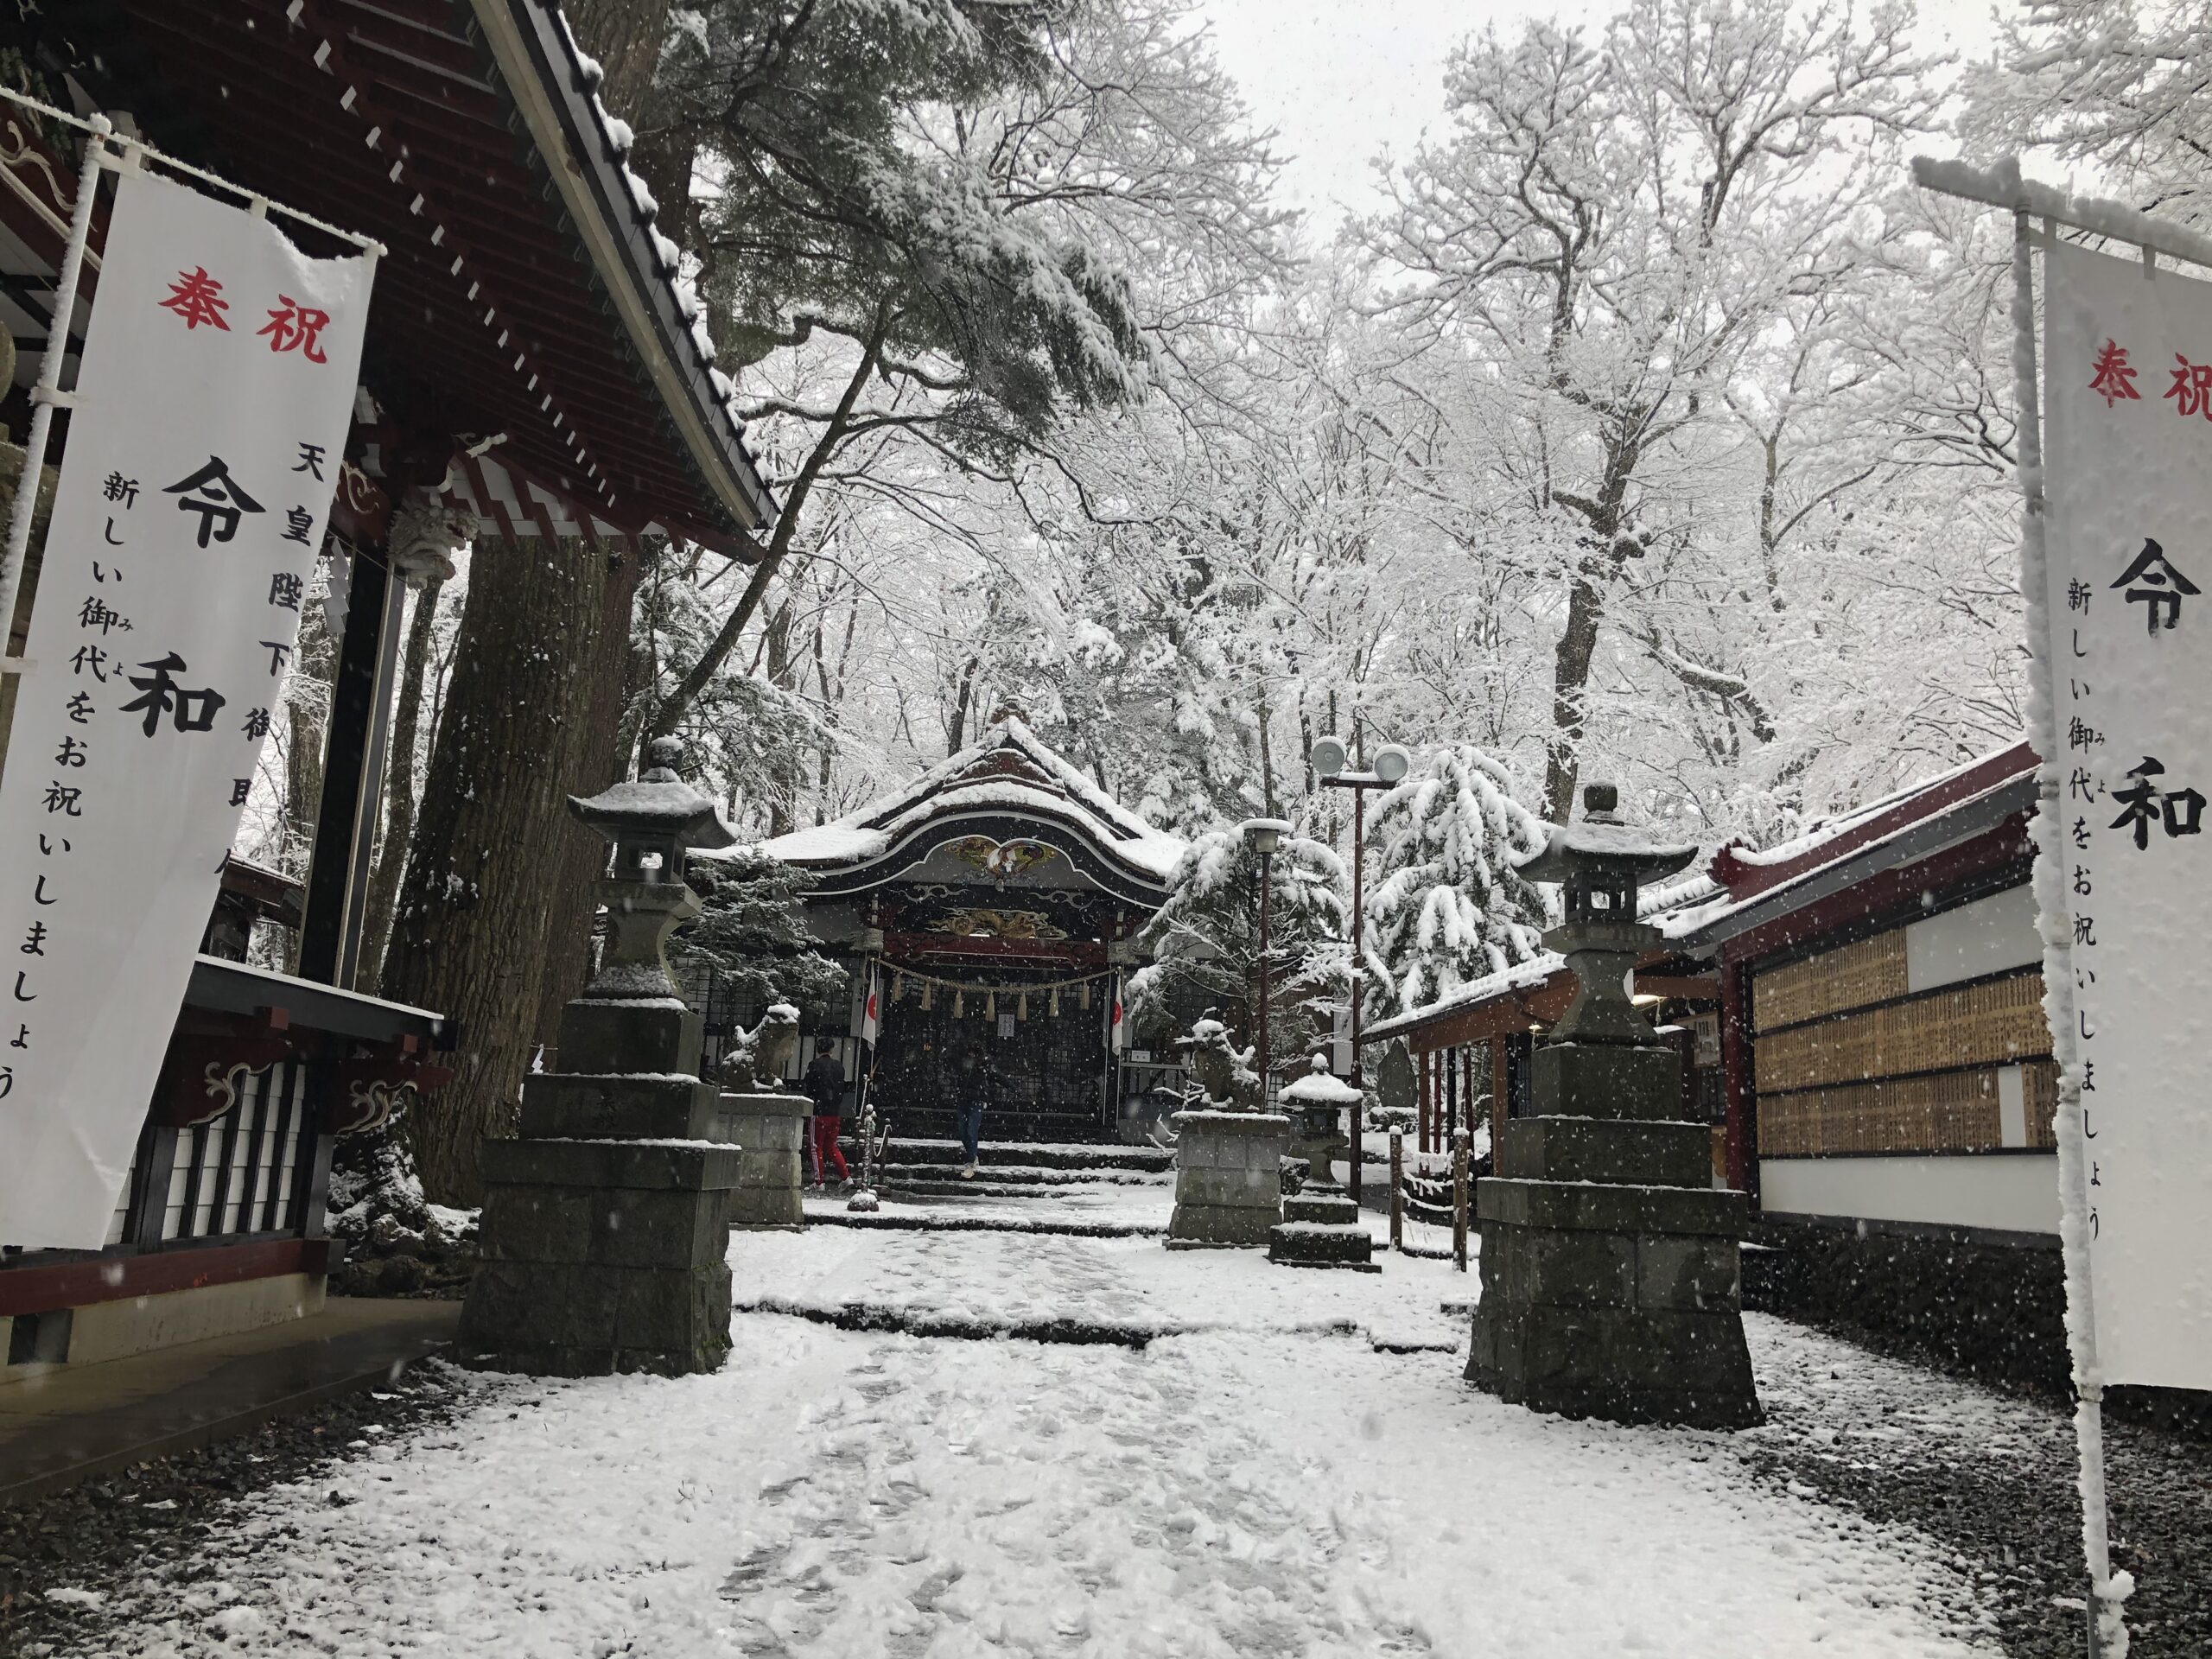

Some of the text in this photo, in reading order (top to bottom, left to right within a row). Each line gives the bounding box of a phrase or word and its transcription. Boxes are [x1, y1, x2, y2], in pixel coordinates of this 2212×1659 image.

[157, 265, 330, 364] 奉祝
[2088, 338, 2212, 421] 奉祝
[118, 454, 267, 738] 令和
[2108, 537, 2208, 851] 令和
[2067, 577, 2102, 1241] 新しい御代をお祝いしましょう
